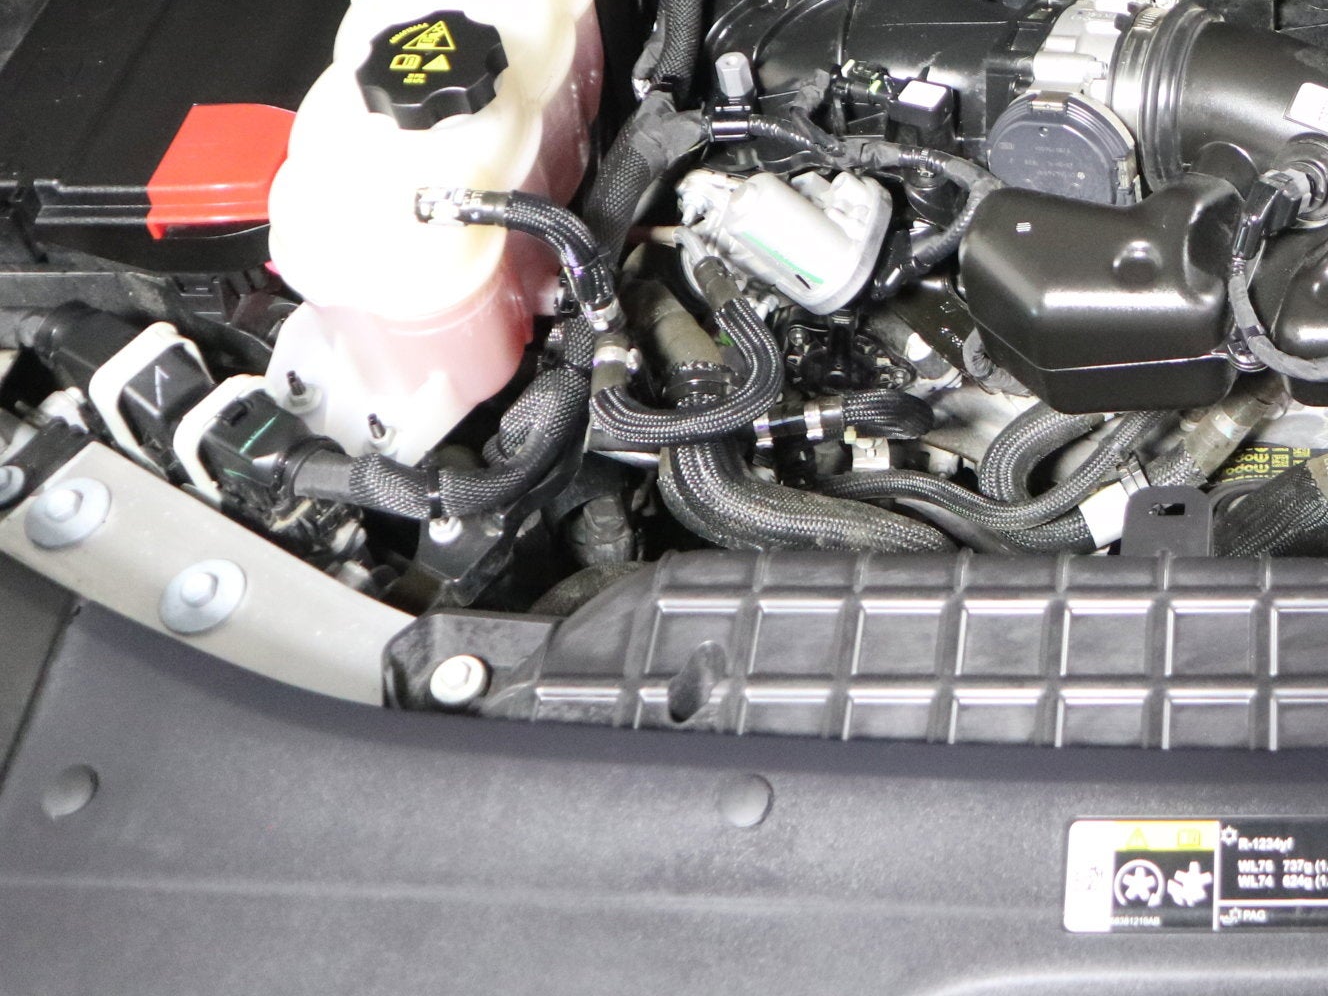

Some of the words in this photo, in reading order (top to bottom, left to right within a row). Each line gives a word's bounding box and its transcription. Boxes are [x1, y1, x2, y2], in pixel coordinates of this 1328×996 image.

[1238, 837, 1294, 852] R-1234yf
[1282, 859, 1313, 875] 737g
[1238, 874, 1274, 888] WL74
[1243, 909, 1267, 921] PAG
